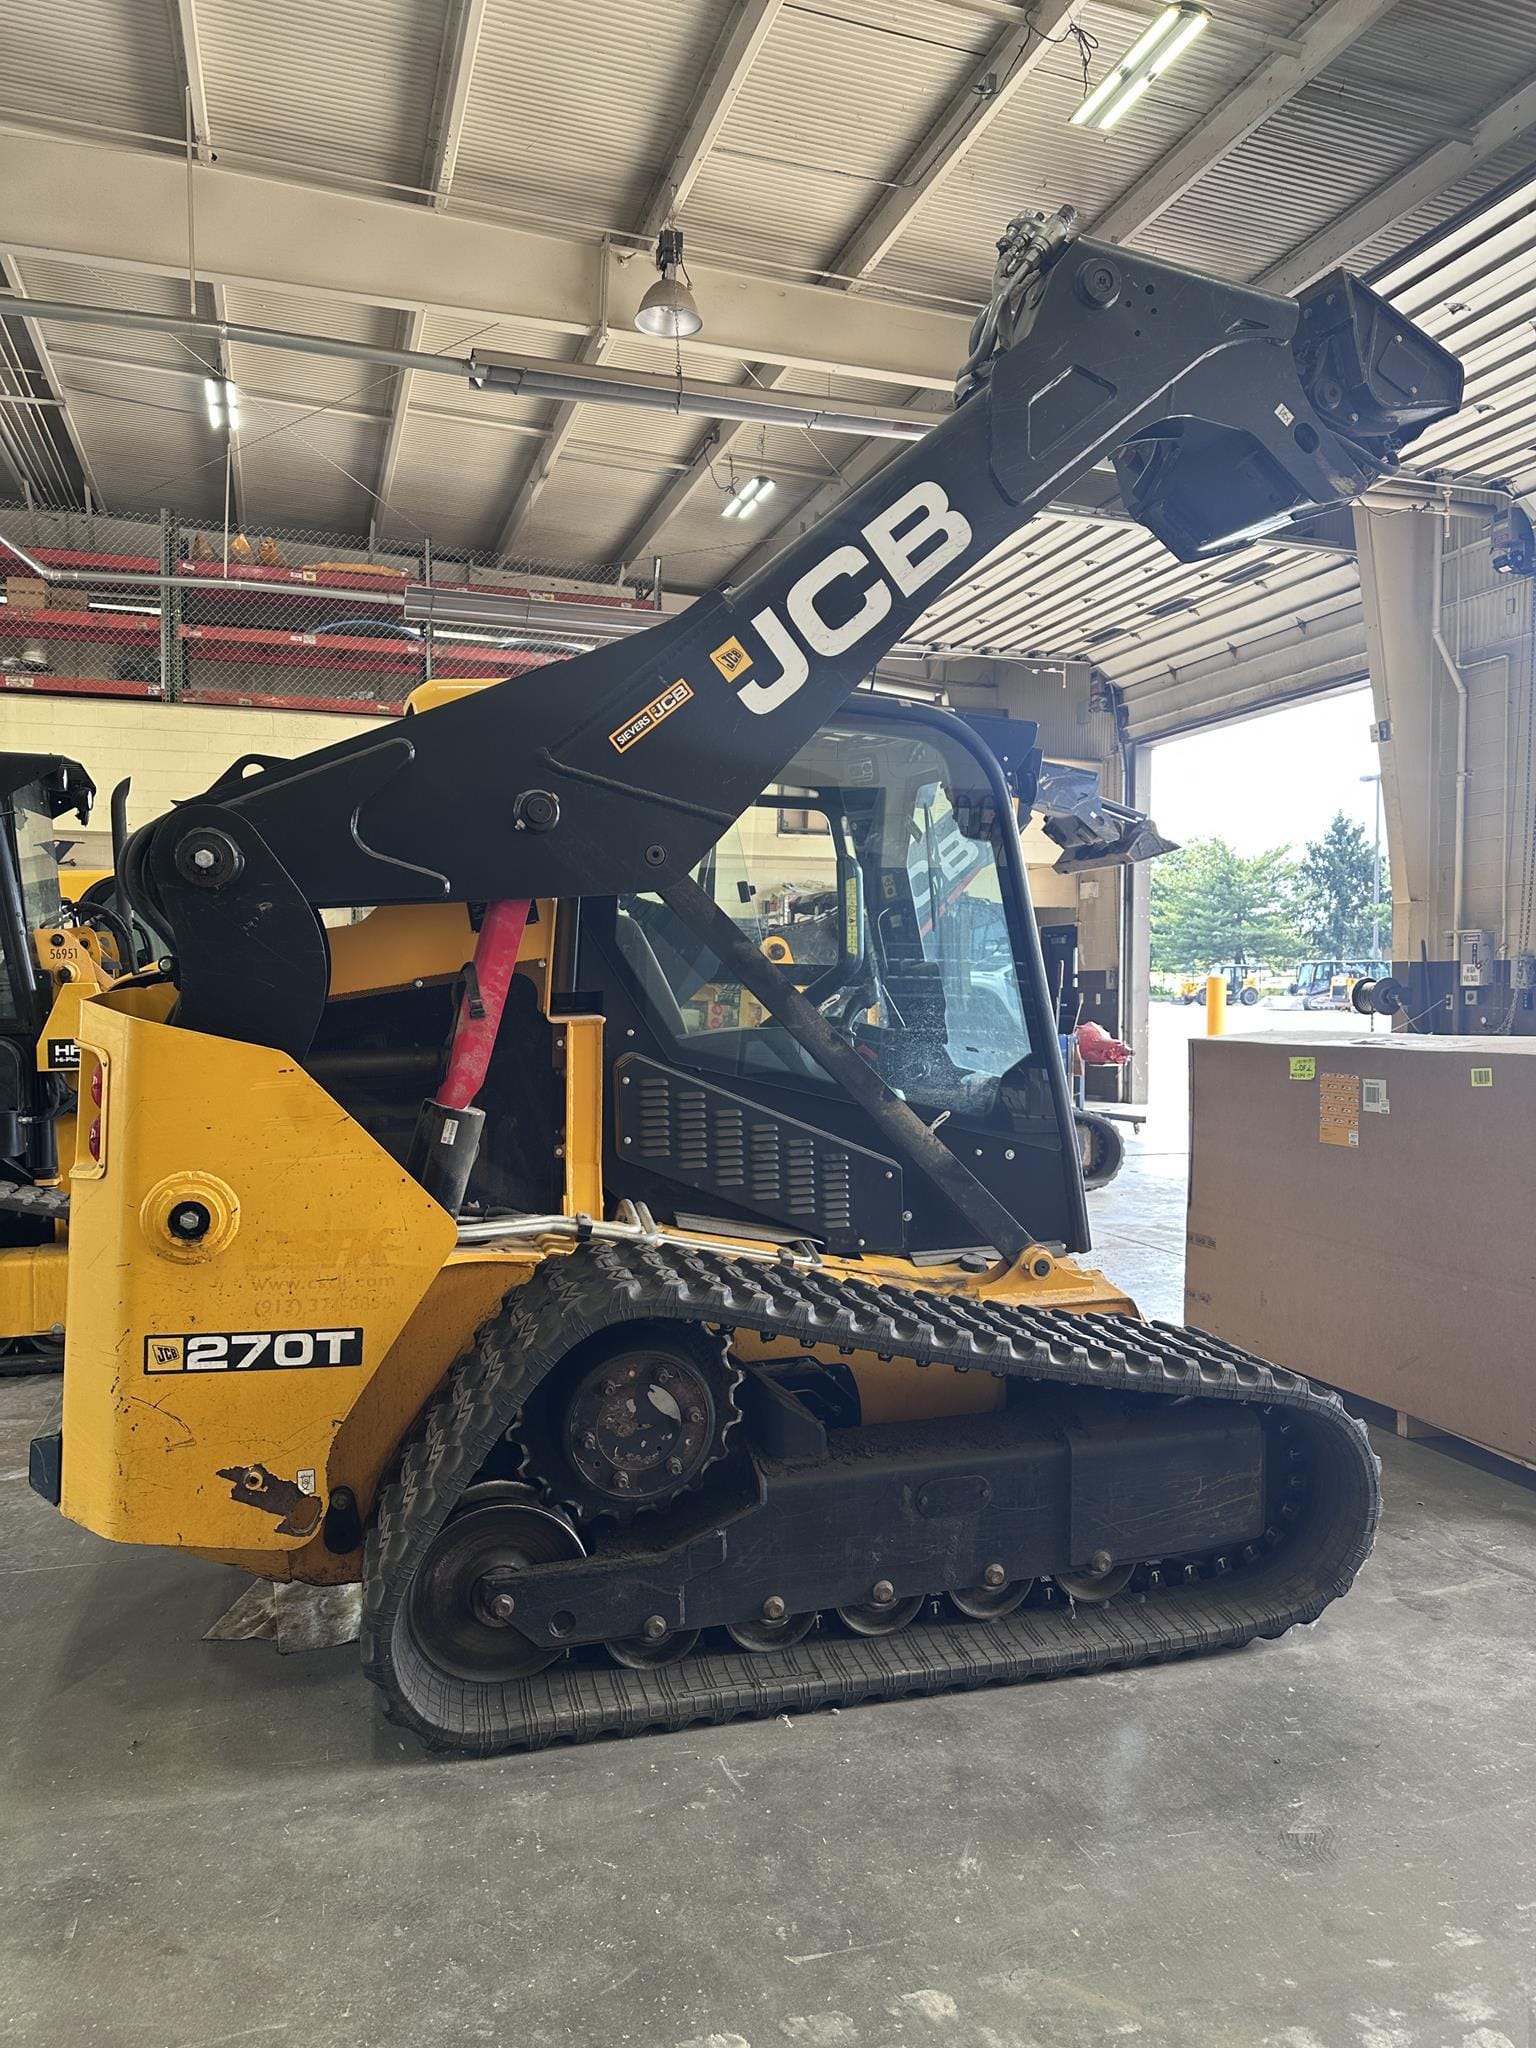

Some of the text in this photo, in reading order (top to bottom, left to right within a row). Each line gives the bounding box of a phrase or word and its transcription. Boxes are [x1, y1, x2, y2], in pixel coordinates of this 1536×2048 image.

[737, 481, 973, 715] JCB
[721, 650, 741, 669] JCB
[616, 684, 689, 745] SIEVERS JCB
[50, 948, 78, 960] 56951
[157, 1331, 355, 1370] JCB 270T
